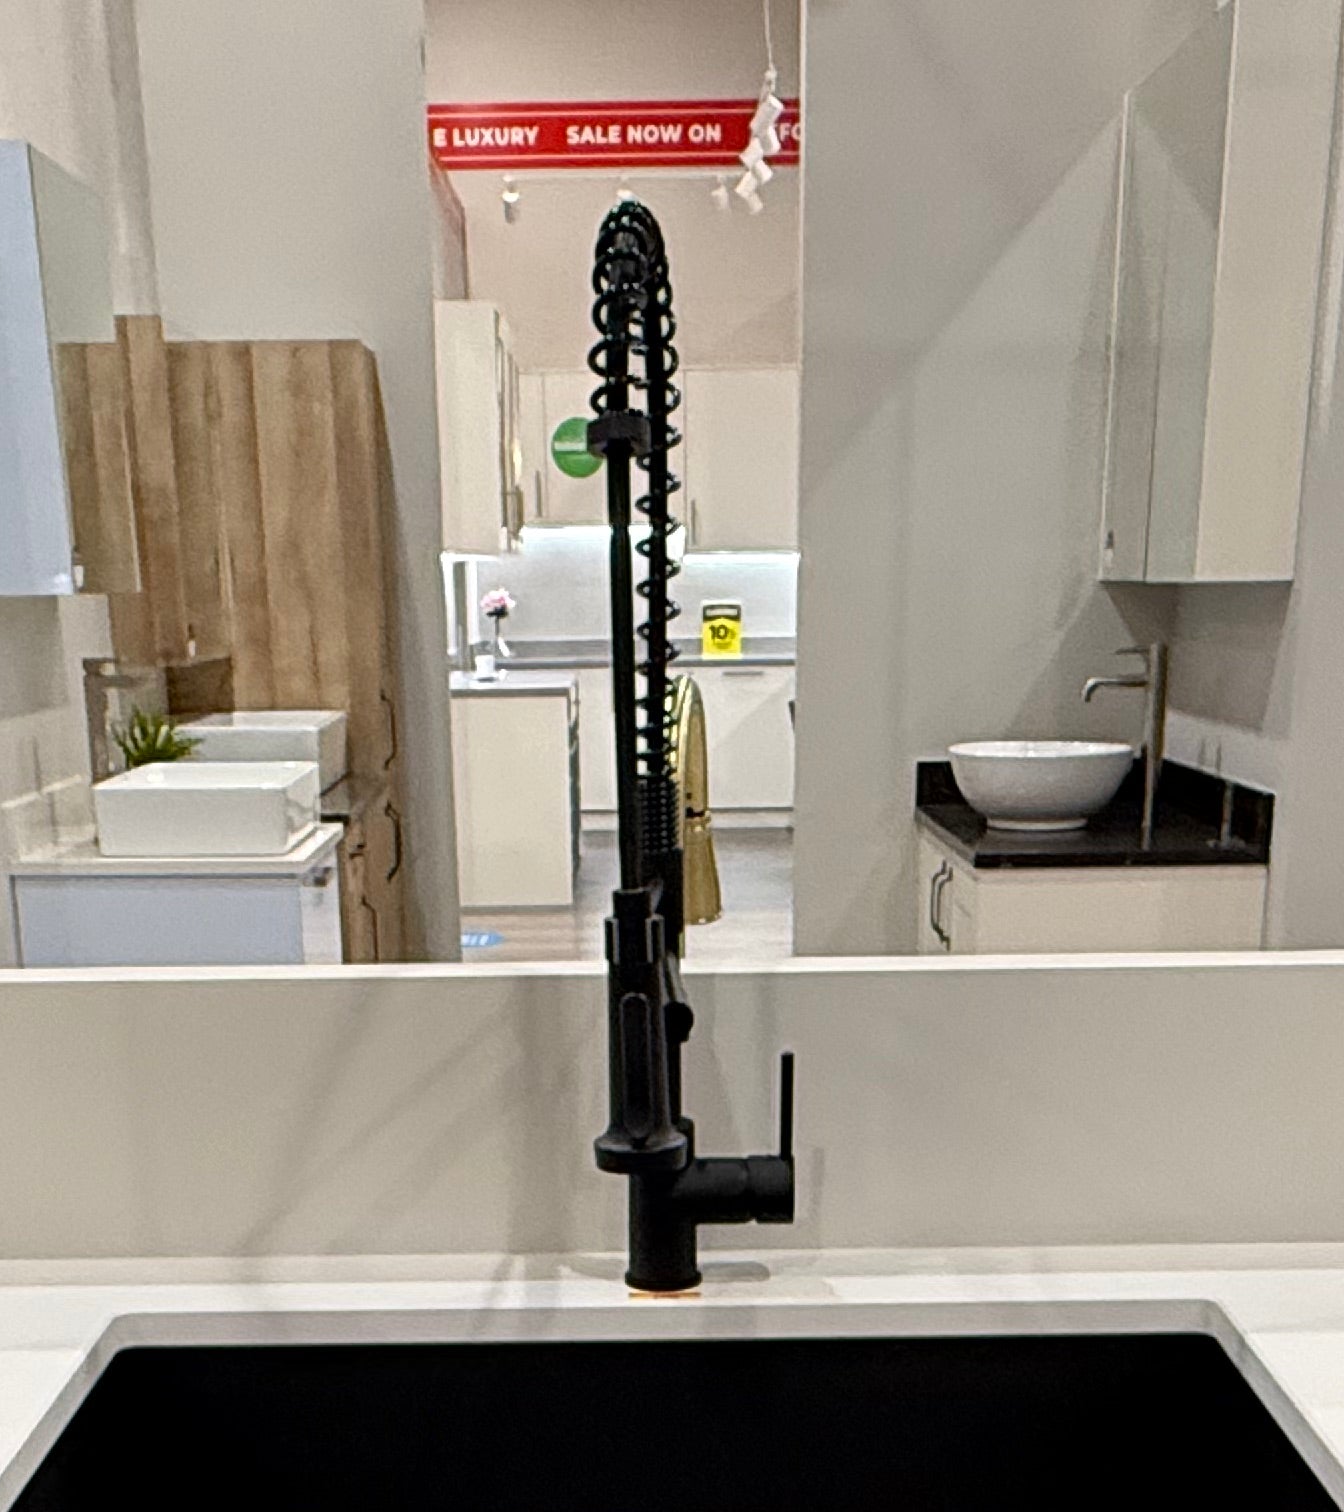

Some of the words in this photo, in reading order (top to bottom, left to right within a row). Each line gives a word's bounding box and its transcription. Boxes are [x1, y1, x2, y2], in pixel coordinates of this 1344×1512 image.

[433, 127, 447, 147] E
[452, 125, 539, 146] LUXURY
[566, 125, 622, 144] SALE
[627, 124, 682, 144] NOW
[688, 124, 722, 143] ON
